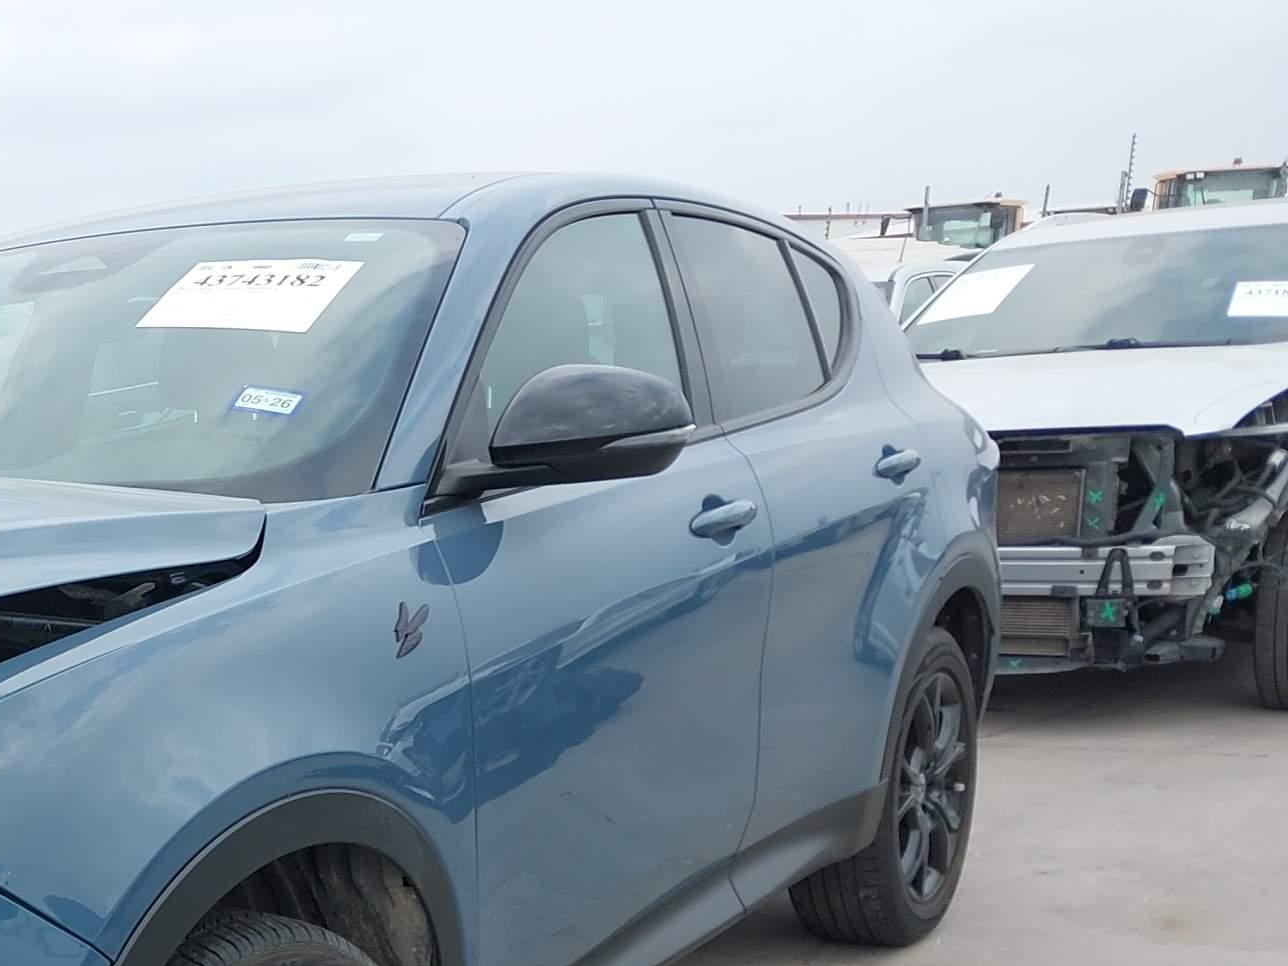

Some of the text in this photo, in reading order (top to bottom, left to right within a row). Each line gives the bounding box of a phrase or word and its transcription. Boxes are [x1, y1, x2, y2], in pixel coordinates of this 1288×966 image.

[194, 274, 326, 287] 43743182
[241, 394, 294, 409] 05 26
